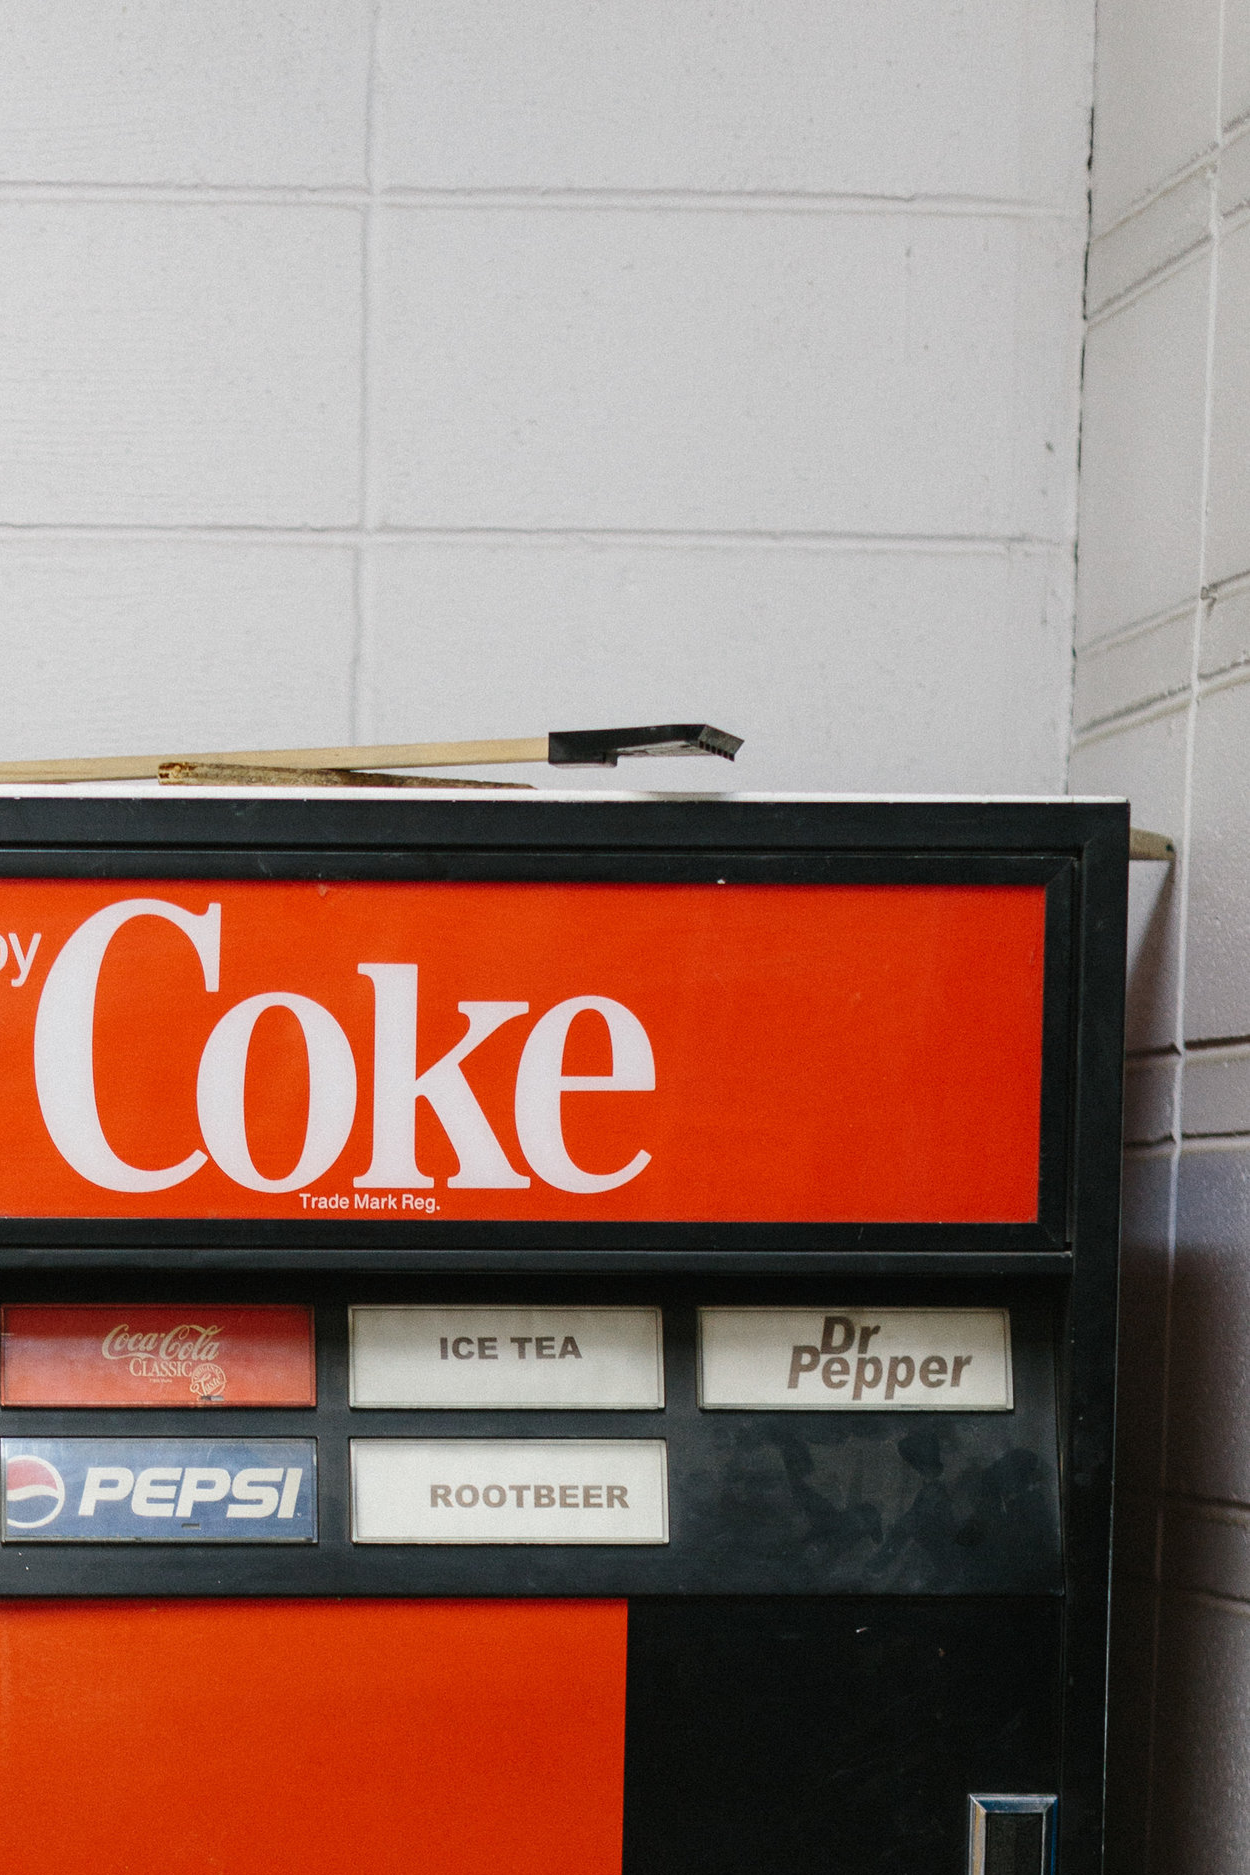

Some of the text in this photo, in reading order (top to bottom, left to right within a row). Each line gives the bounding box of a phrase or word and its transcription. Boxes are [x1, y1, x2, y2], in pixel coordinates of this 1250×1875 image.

[33, 897, 657, 1196] Coke
[299, 1193, 441, 1214] Trade Mark Reg.
[440, 1336, 583, 1360] ICE TEA
[820, 1316, 881, 1356] Dr
[129, 1358, 192, 1377] CLASSIC
[787, 1344, 972, 1400] Pepper
[78, 1467, 302, 1518] PEPSI
[429, 1484, 630, 1509] ROOTBEER
